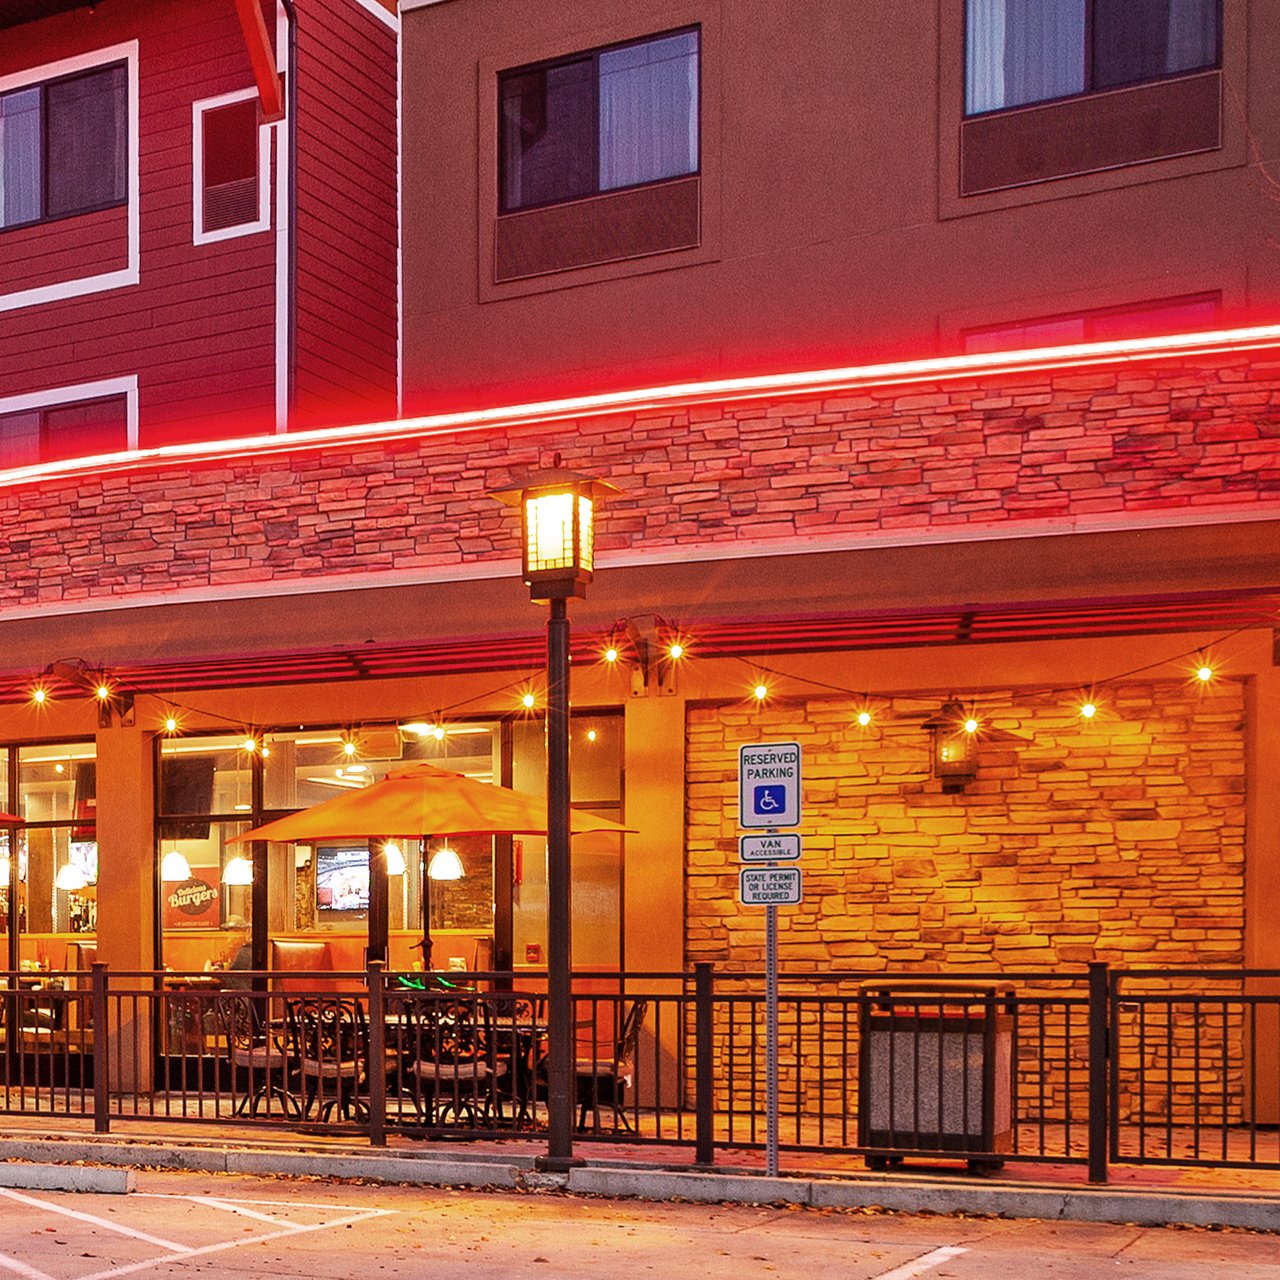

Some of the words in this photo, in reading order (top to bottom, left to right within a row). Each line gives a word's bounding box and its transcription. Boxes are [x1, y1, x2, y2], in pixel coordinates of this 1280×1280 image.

[743, 752, 797, 766] RESERVED
[747, 767, 794, 780] PARKING
[760, 840, 781, 848] VAN
[745, 874, 766, 882] STATE
[769, 873, 796, 881] PERMIT
[748, 883, 759, 891] OR
[762, 882, 793, 891] LICENSE
[168, 888, 218, 908] Burgers
[752, 892, 789, 900] REQUIRED
